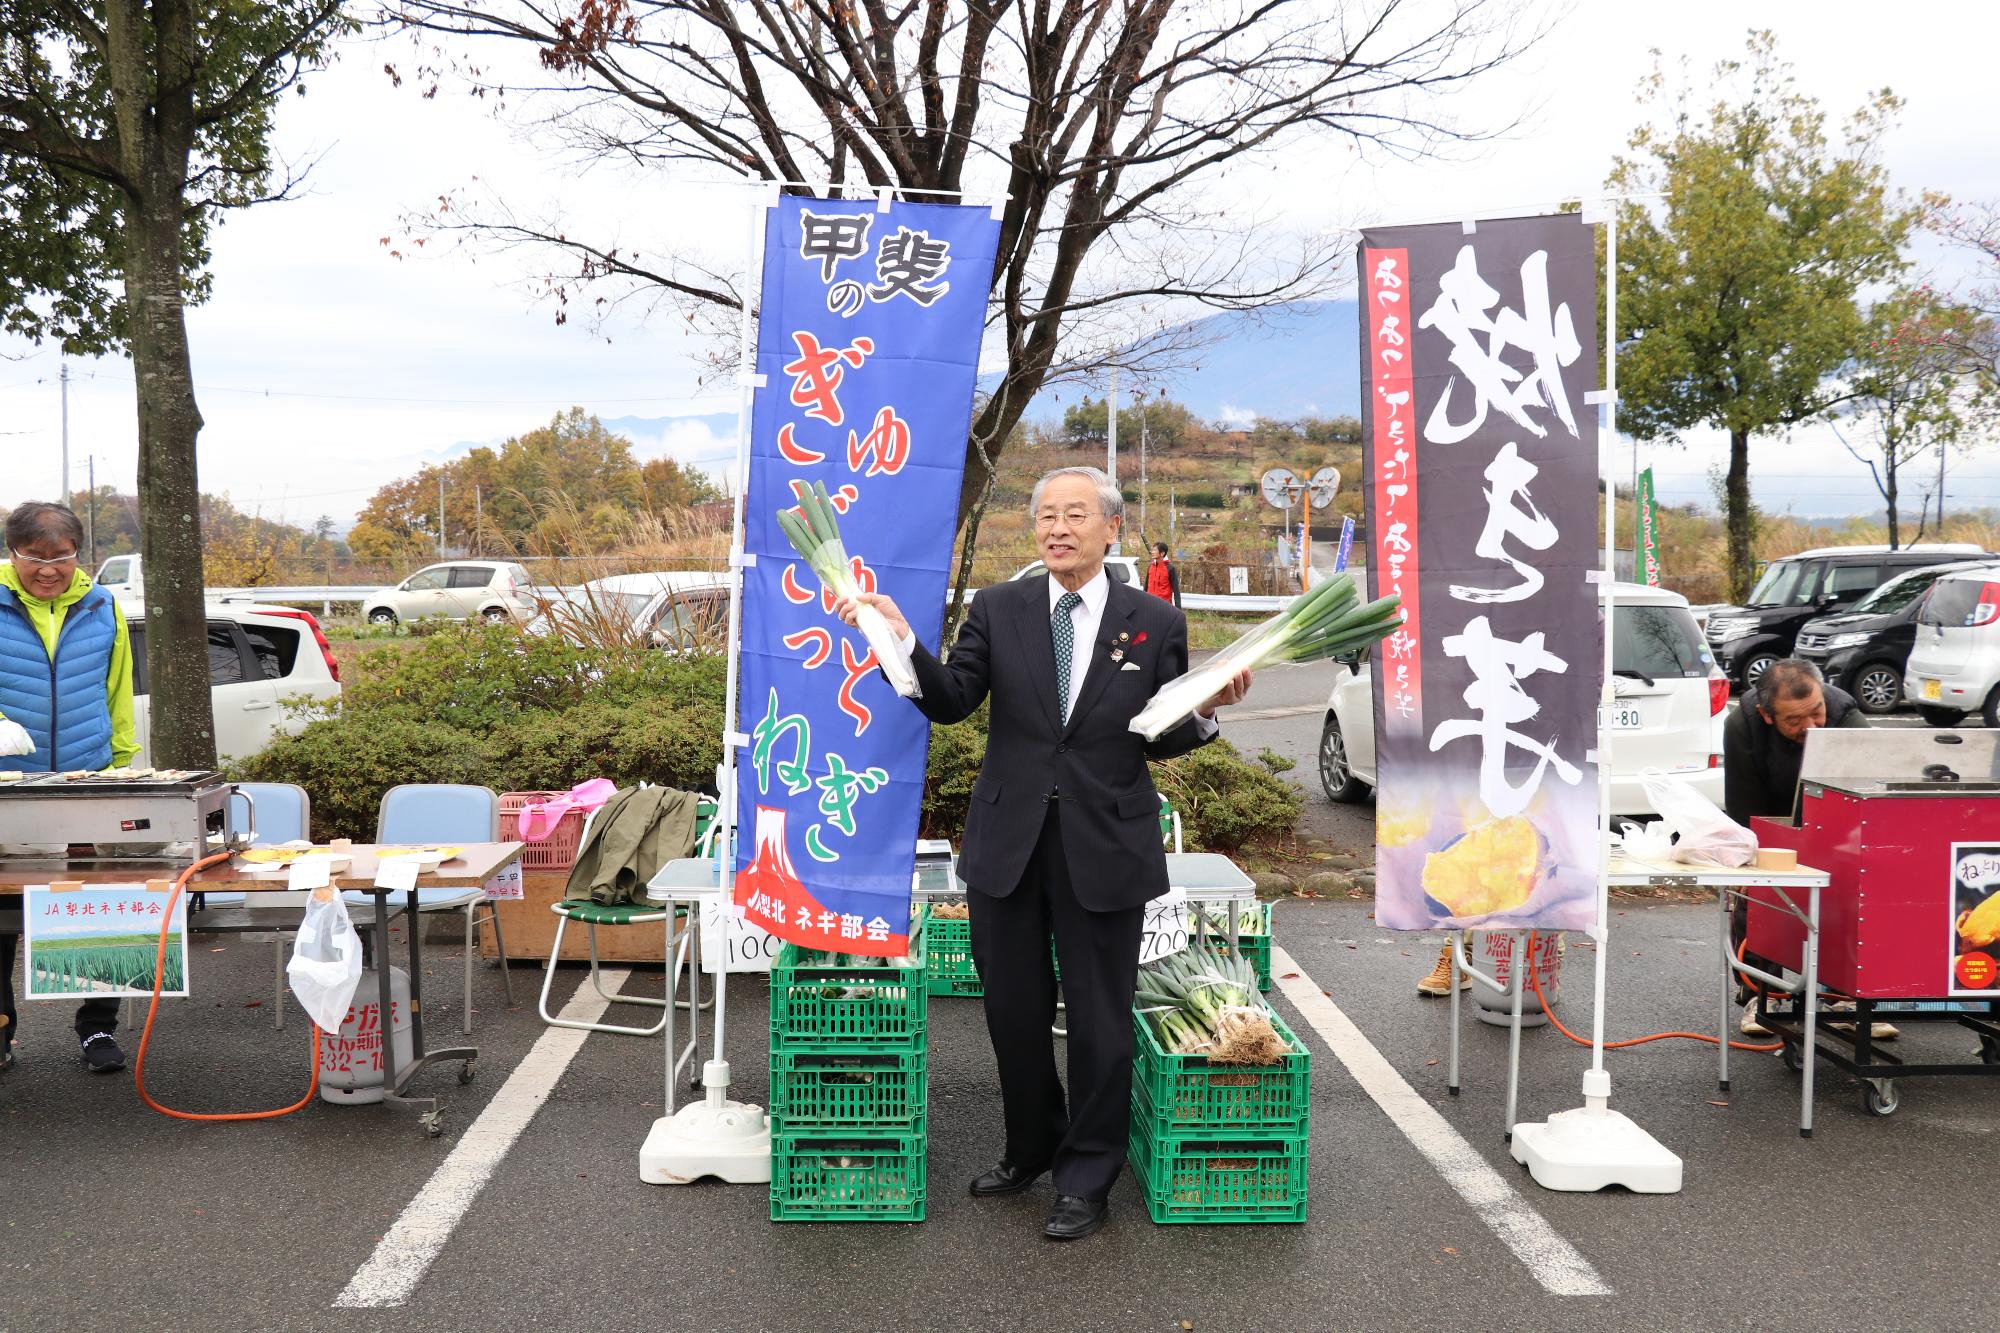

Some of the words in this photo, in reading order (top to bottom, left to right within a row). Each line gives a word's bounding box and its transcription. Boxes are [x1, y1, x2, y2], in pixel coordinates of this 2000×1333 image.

[801, 208, 952, 318] 甲斐の
[1598, 710, 1639, 726] -80
[795, 905, 892, 943] ネギ部会
